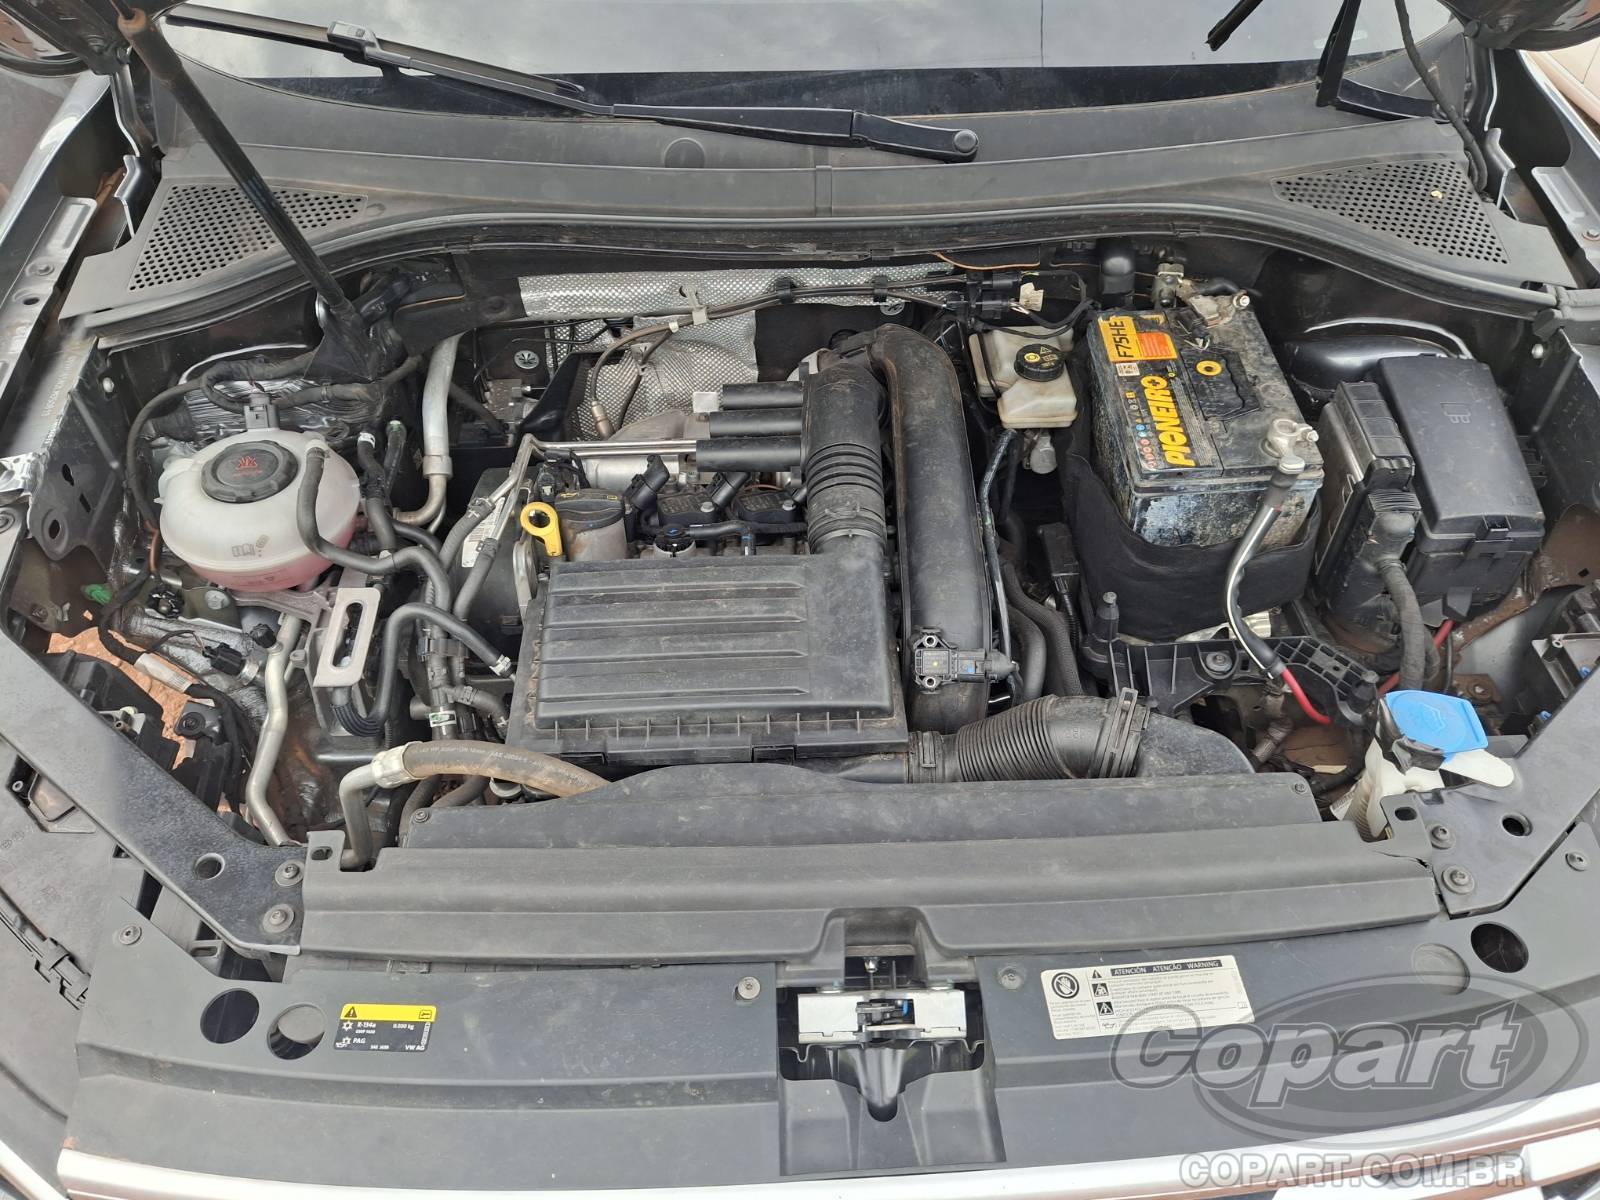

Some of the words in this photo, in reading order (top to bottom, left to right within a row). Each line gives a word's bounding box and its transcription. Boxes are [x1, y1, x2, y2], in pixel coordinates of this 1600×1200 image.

[1109, 320, 1134, 358] F75HE
[1140, 375, 1196, 467] PIONEIRO
[1114, 966, 1147, 975] ATENCIÓN
[1152, 963, 1182, 973] ATENÇÃO
[1187, 960, 1219, 969] WARNING
